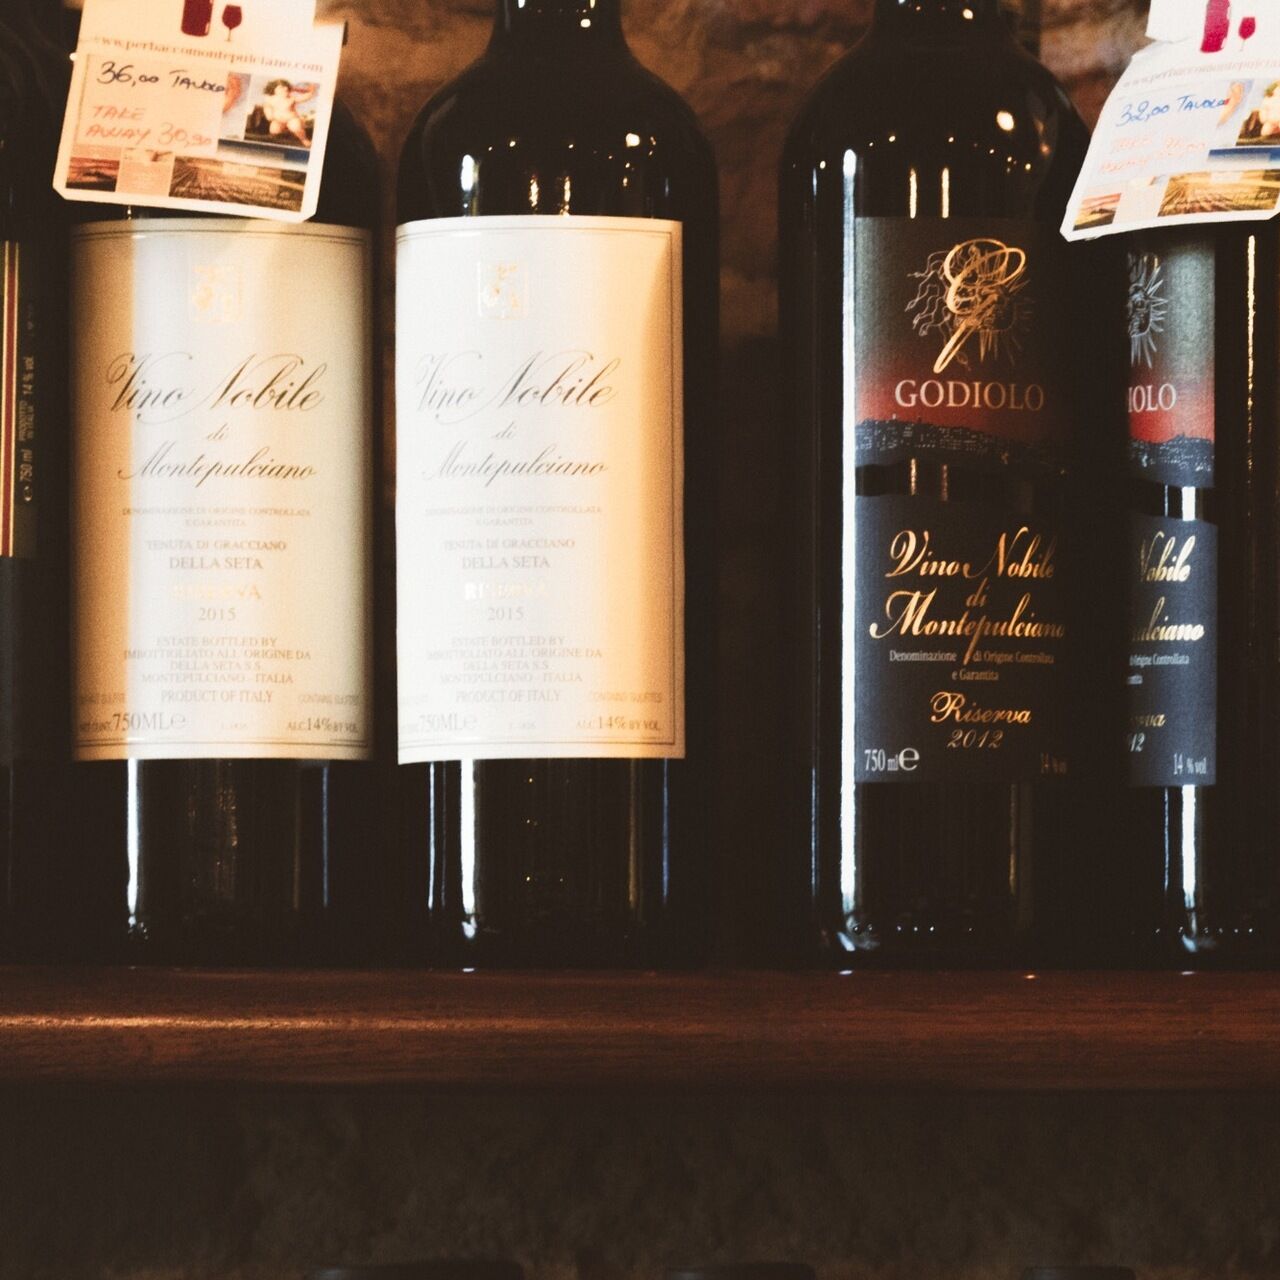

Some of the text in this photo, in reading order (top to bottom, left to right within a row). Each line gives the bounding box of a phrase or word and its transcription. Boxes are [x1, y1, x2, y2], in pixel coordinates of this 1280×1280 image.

[106, 351, 327, 418] Vino Nobile
[462, 351, 620, 417] Nobile
[894, 379, 1046, 412] GODIOLO
[117, 440, 317, 488] Montepulciano
[884, 526, 1056, 579] Vino Nobile
[963, 577, 987, 608] di
[868, 586, 1066, 666] Montepulciano
[930, 691, 1032, 724] Riserva
[945, 728, 1002, 749] 2012
